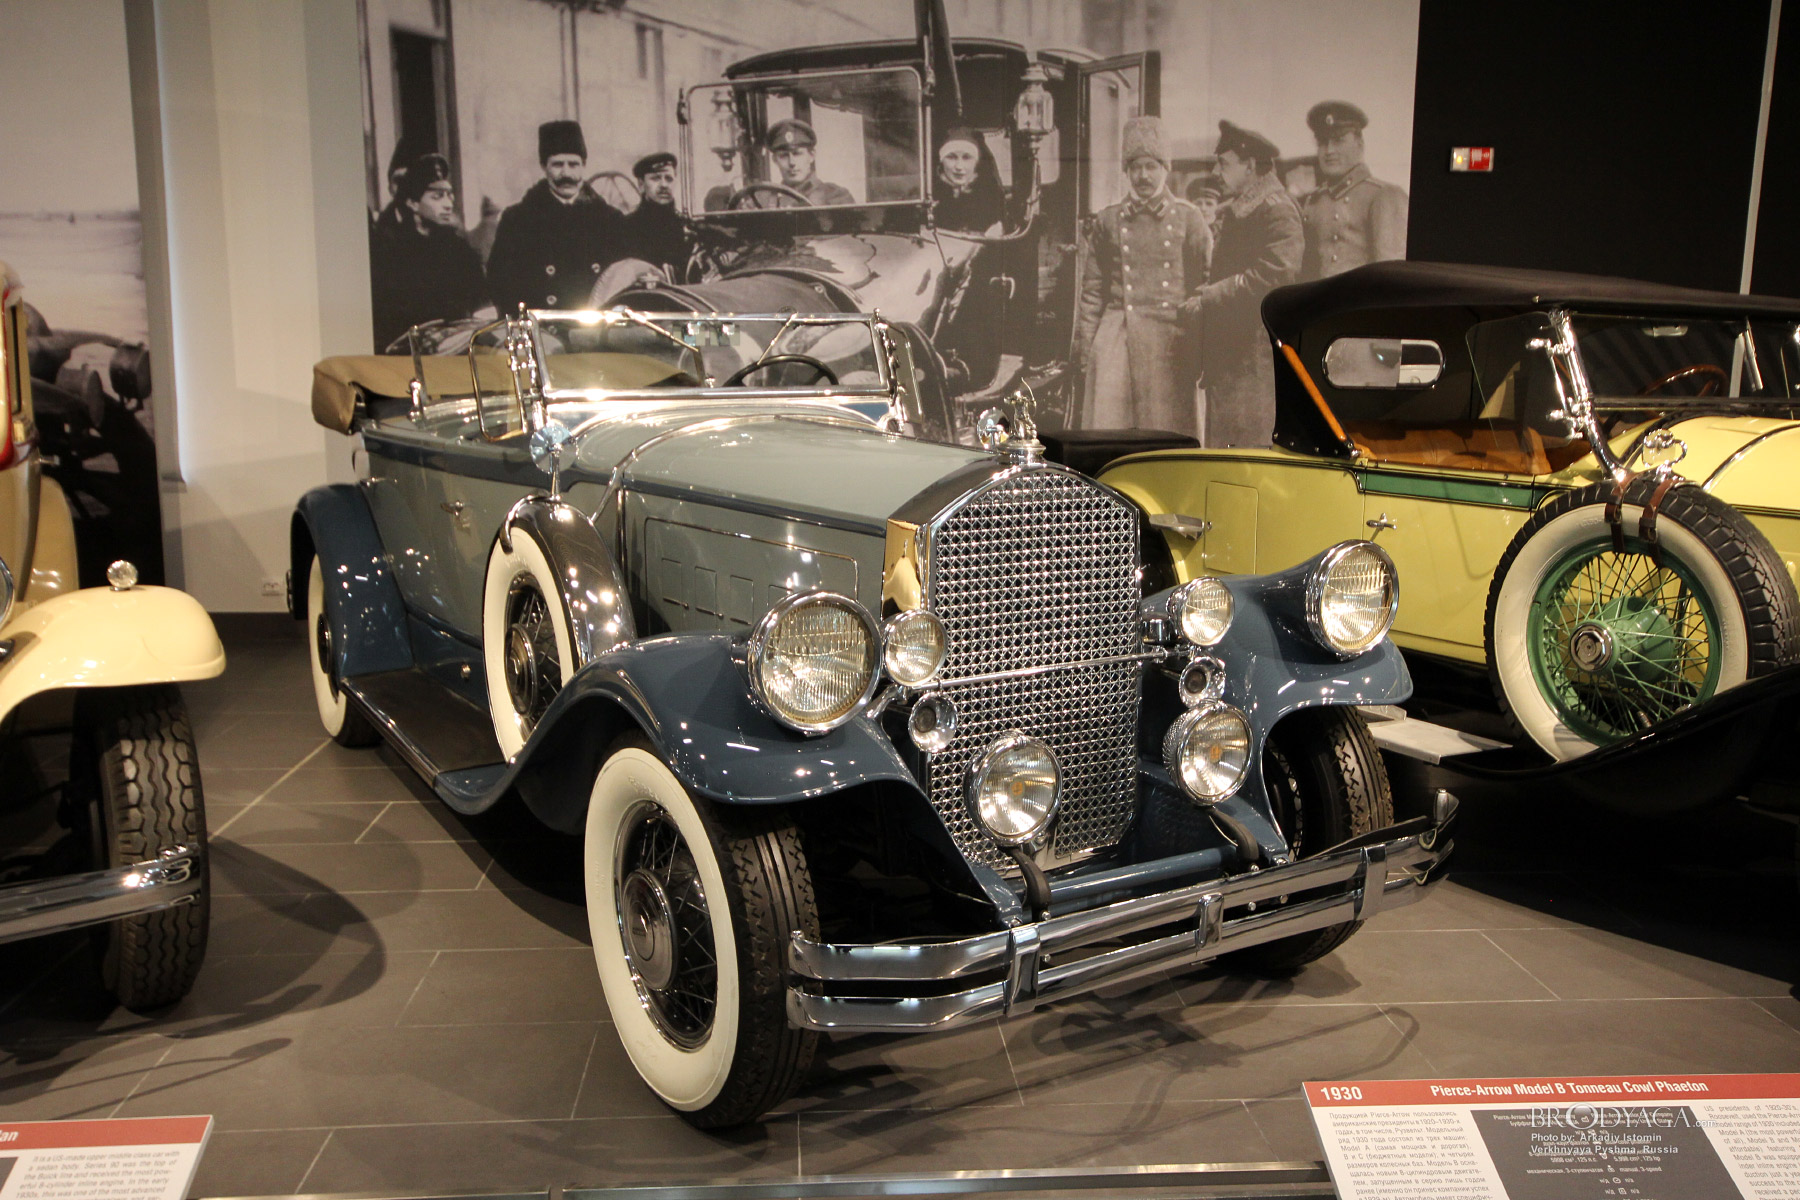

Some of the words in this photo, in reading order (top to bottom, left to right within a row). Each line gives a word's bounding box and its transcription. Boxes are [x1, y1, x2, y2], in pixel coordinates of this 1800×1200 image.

[1320, 1086, 1363, 1101] 1930
[1429, 1084, 1512, 1096] Pierce-Arrow
[1513, 1083, 1554, 1095] Model
[1554, 1082, 1566, 1094] B
[1566, 1082, 1622, 1094] Tonneau
[1622, 1081, 1655, 1093] Cowl
[1655, 1080, 1709, 1092] Phaeton
